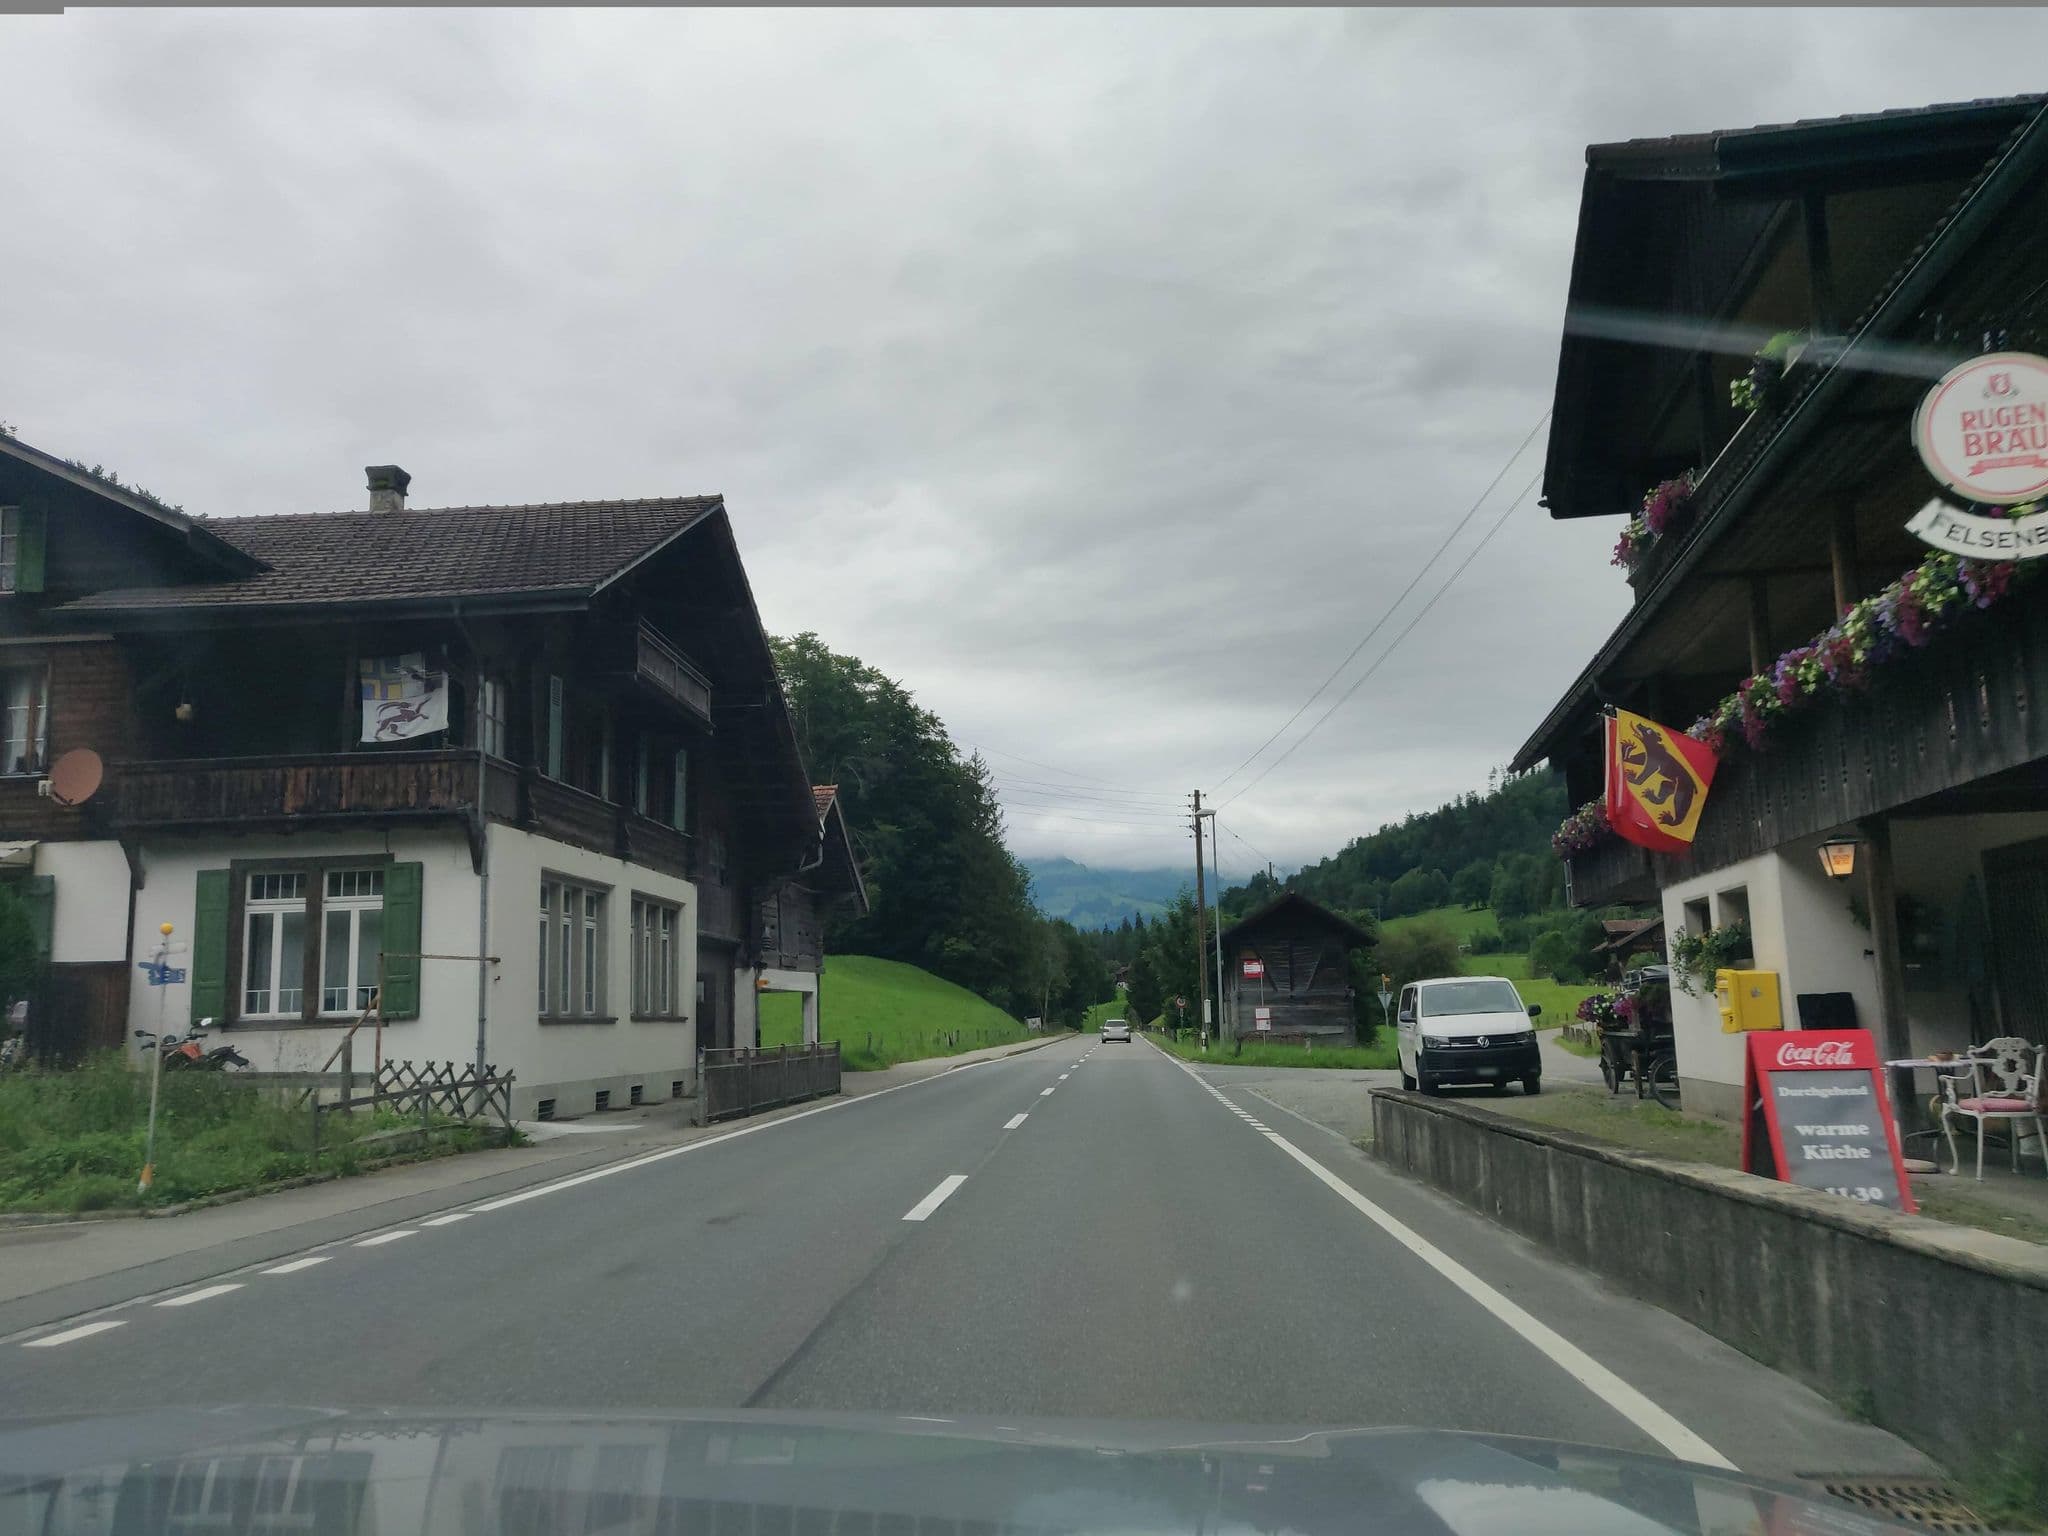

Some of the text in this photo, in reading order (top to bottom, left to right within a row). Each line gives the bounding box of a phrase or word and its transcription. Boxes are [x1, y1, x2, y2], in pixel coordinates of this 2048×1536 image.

[1962, 403, 2046, 431] RUGEN
[1777, 1042, 1856, 1066] Coca-Cola
[1795, 1125, 1870, 1136] warme
[1802, 1145, 1872, 1160] Küche
